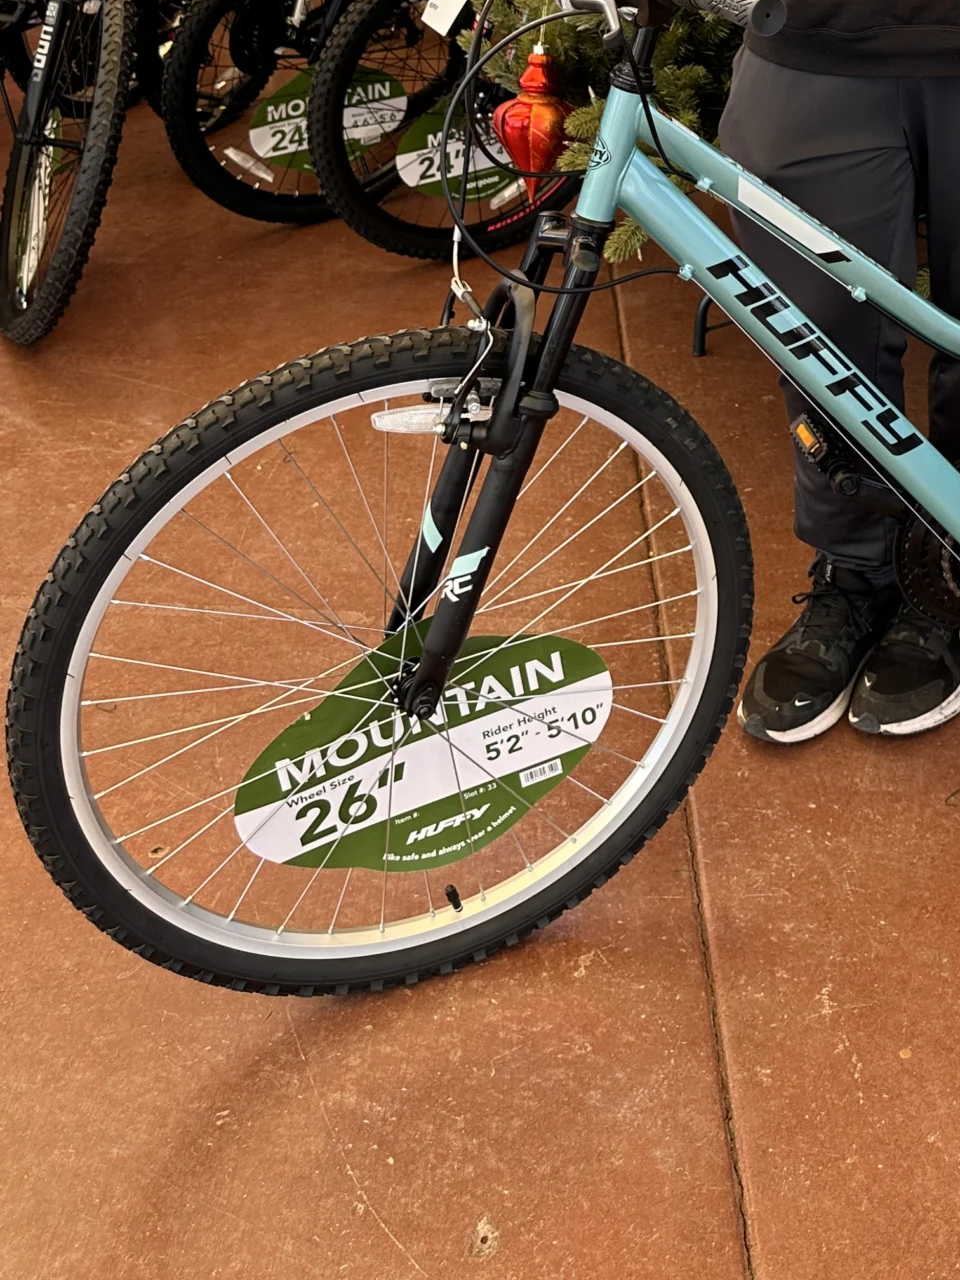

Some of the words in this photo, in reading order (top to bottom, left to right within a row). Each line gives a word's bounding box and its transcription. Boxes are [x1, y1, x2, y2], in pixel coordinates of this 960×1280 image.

[267, 81, 391, 122] MOTAIN
[705, 254, 925, 457] HUFFY
[440, 574, 474, 602] RC
[274, 651, 565, 793] MOUNTAIN
[482, 722, 514, 740] Rider
[517, 706, 558, 728] Height
[485, 729, 529, 762] 5'2"
[547, 702, 604, 739] 5'10"
[285, 785, 327, 809] Wheel
[330, 773, 355, 791] Size
[295, 761, 406, 847] 26"
[463, 790, 478, 800] Slot
[487, 782, 498, 792] 33
[394, 815, 412, 826] Item
[402, 852, 420, 862] safe
[421, 848, 437, 860] and
[438, 840, 466, 857] always
[491, 805, 517, 828] helmet
[405, 803, 491, 846] HUFFY
